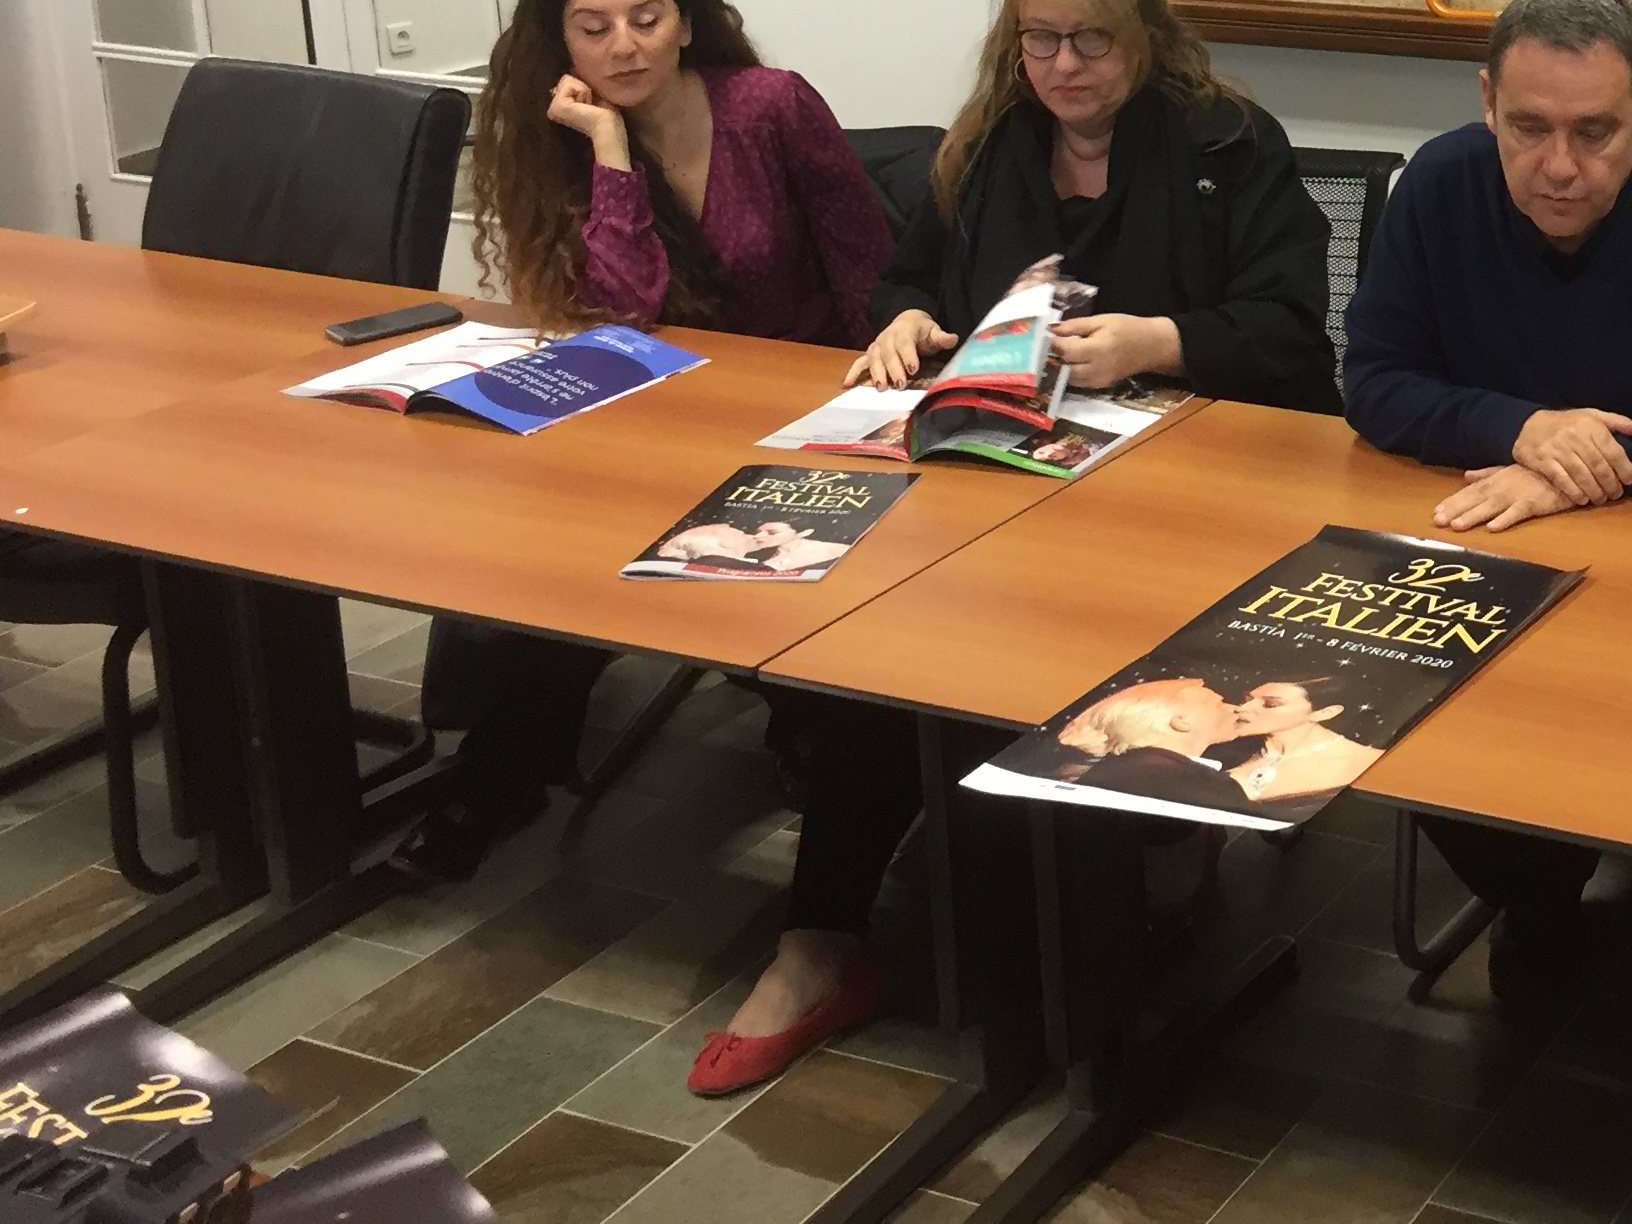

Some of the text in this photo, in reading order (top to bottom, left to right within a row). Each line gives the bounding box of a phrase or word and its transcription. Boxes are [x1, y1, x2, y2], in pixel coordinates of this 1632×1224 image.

[725, 486, 874, 509] ITALIEN
[755, 478, 871, 496] FESTIVAL
[1238, 585, 1508, 654] ITALIEN
[1301, 572, 1510, 626] FESTIVAL
[1228, 619, 1286, 638] BASTIA
[1326, 637, 1340, 648] 8
[1340, 639, 1409, 661] FÉVRIER
[1410, 653, 1454, 669] 2020
